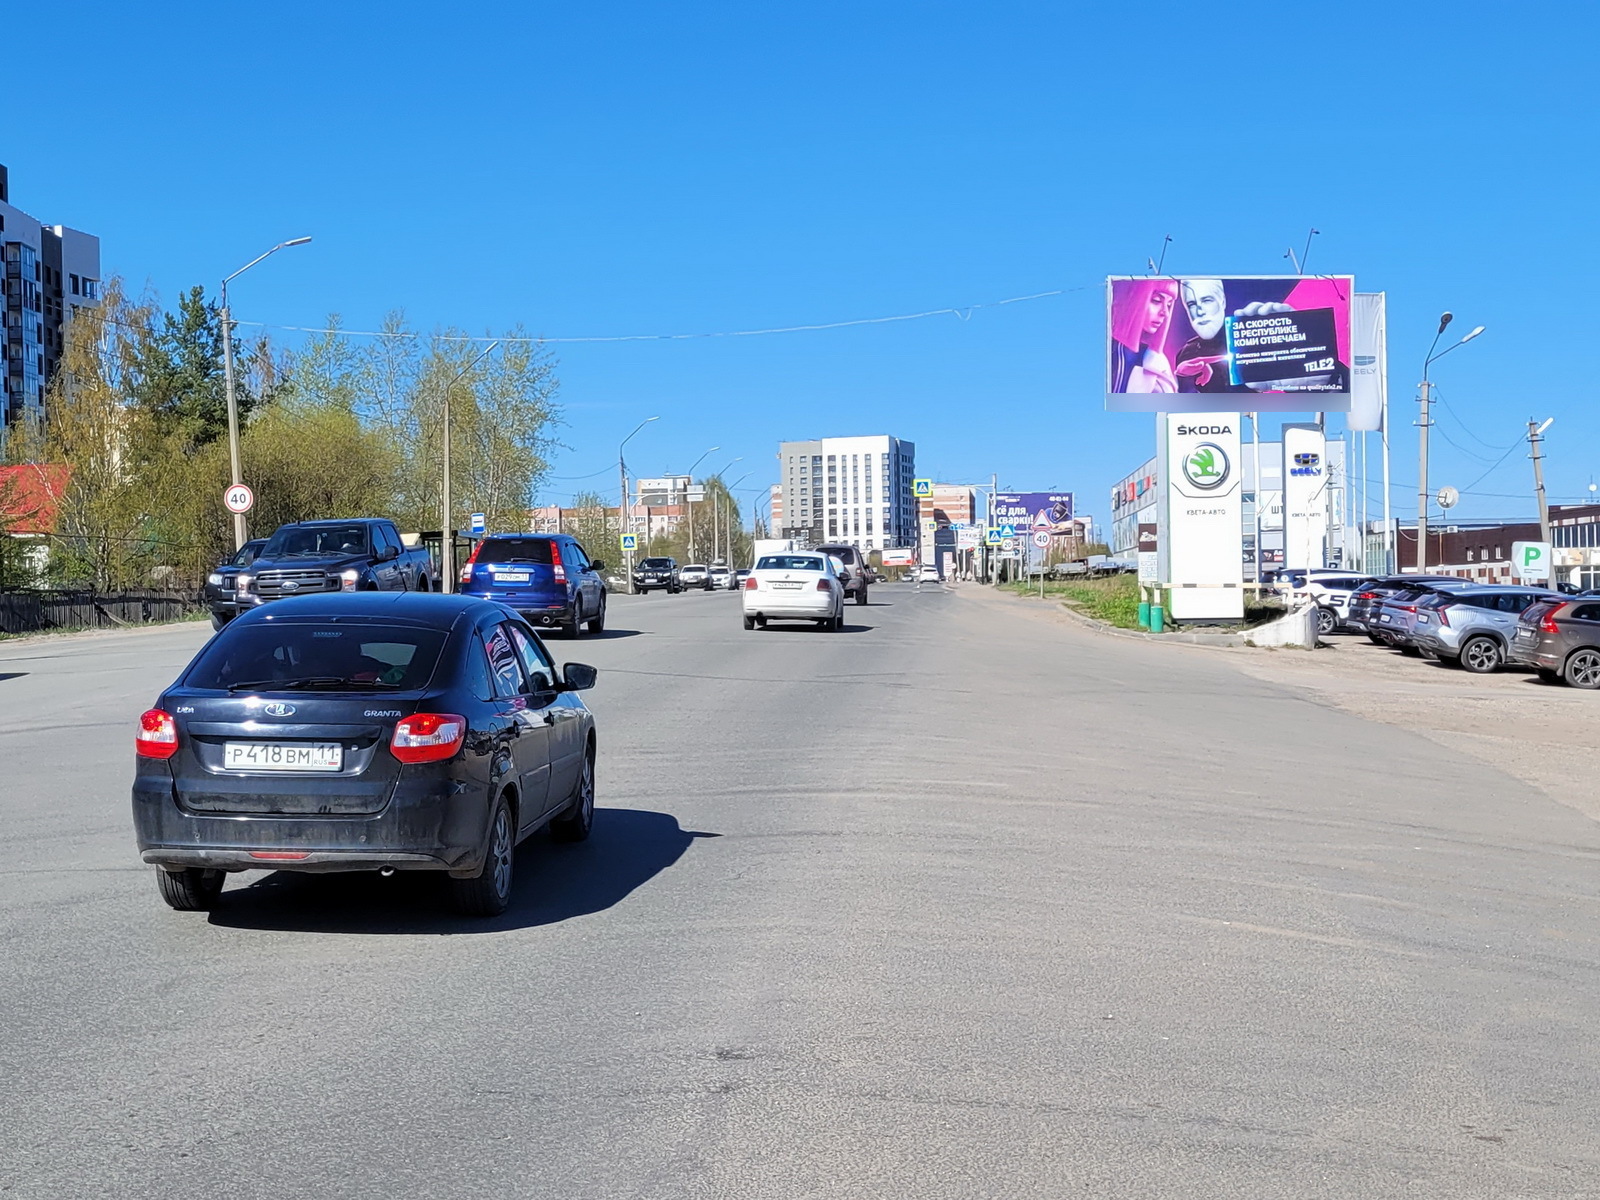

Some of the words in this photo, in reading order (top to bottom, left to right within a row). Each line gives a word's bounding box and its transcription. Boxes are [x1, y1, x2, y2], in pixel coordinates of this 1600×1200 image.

[1232, 321, 1245, 330] ЗА
[1245, 317, 1292, 329] СКОРОСТЬ
[1233, 330, 1239, 338] В
[1241, 325, 1298, 337] РЕСПУБЛИКЕ
[1234, 337, 1259, 347] КОМИ
[1260, 333, 1307, 345] ОТВЕЧАЕМ
[1304, 357, 1335, 372] TELE2
[1177, 424, 1232, 435] ŠKODA
[1290, 467, 1322, 476] GEELY
[231, 493, 246, 504] 40
[1007, 507, 1027, 516] для
[998, 514, 1034, 526] сварки!
[1036, 534, 1048, 543] 40
[317, 745, 335, 759] 11
